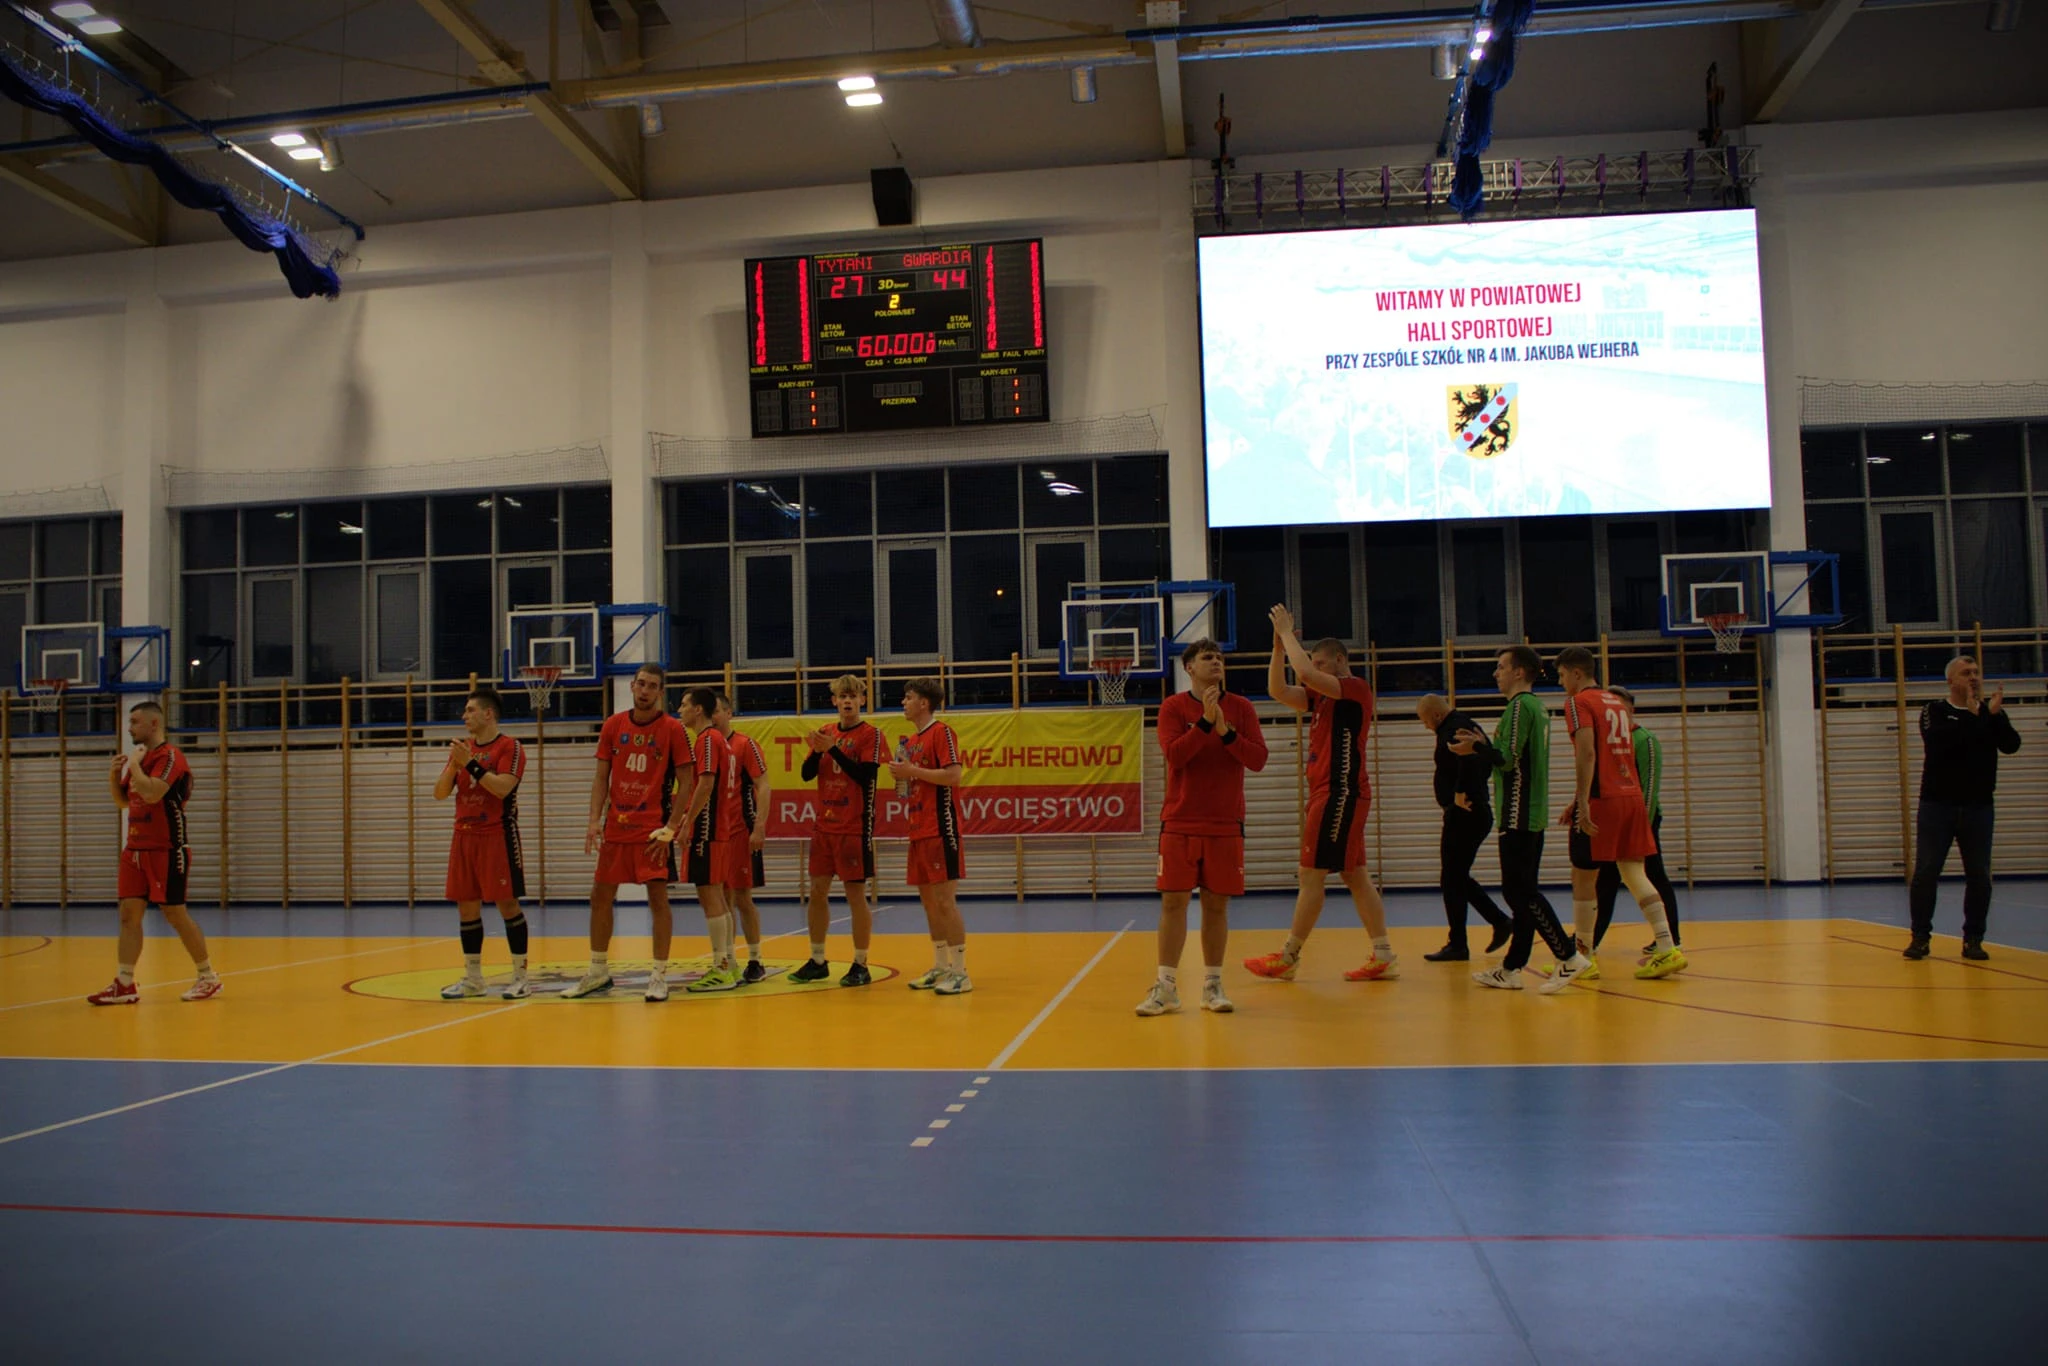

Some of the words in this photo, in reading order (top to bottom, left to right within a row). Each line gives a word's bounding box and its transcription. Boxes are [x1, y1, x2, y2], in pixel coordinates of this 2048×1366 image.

[817, 256, 873, 273] TYTANI
[903, 250, 971, 268] GWARDIA
[830, 275, 864, 299] 27
[877, 279, 894, 290] 3D
[933, 269, 967, 290] 44
[888, 294, 900, 309] 2
[1376, 289, 1443, 311] WITAMY
[1450, 288, 1465, 308] W
[1471, 283, 1581, 307] POWIATOWEJ
[823, 323, 842, 331] STAN
[1408, 321, 1445, 342] HALI
[1452, 316, 1552, 341] SPORTOWEJ
[938, 339, 956, 347] FAUL
[865, 359, 884, 367] CZAS
[893, 357, 912, 365] CZAS
[1002, 350, 1022, 358] FAUL
[1326, 353, 1359, 370] PRZY
[1422, 346, 1464, 365] SZKÓŁ
[1468, 348, 1485, 364] NR
[1489, 347, 1497, 363] 4
[1501, 347, 1520, 362] IM.
[1524, 344, 1574, 361] JAKUBA
[1577, 341, 1639, 359] WEJHERA
[771, 364, 789, 372] FAUL
[1605, 708, 1631, 744] 24
[625, 753, 647, 773] 40
[960, 745, 1123, 769] WEJHEROWO
